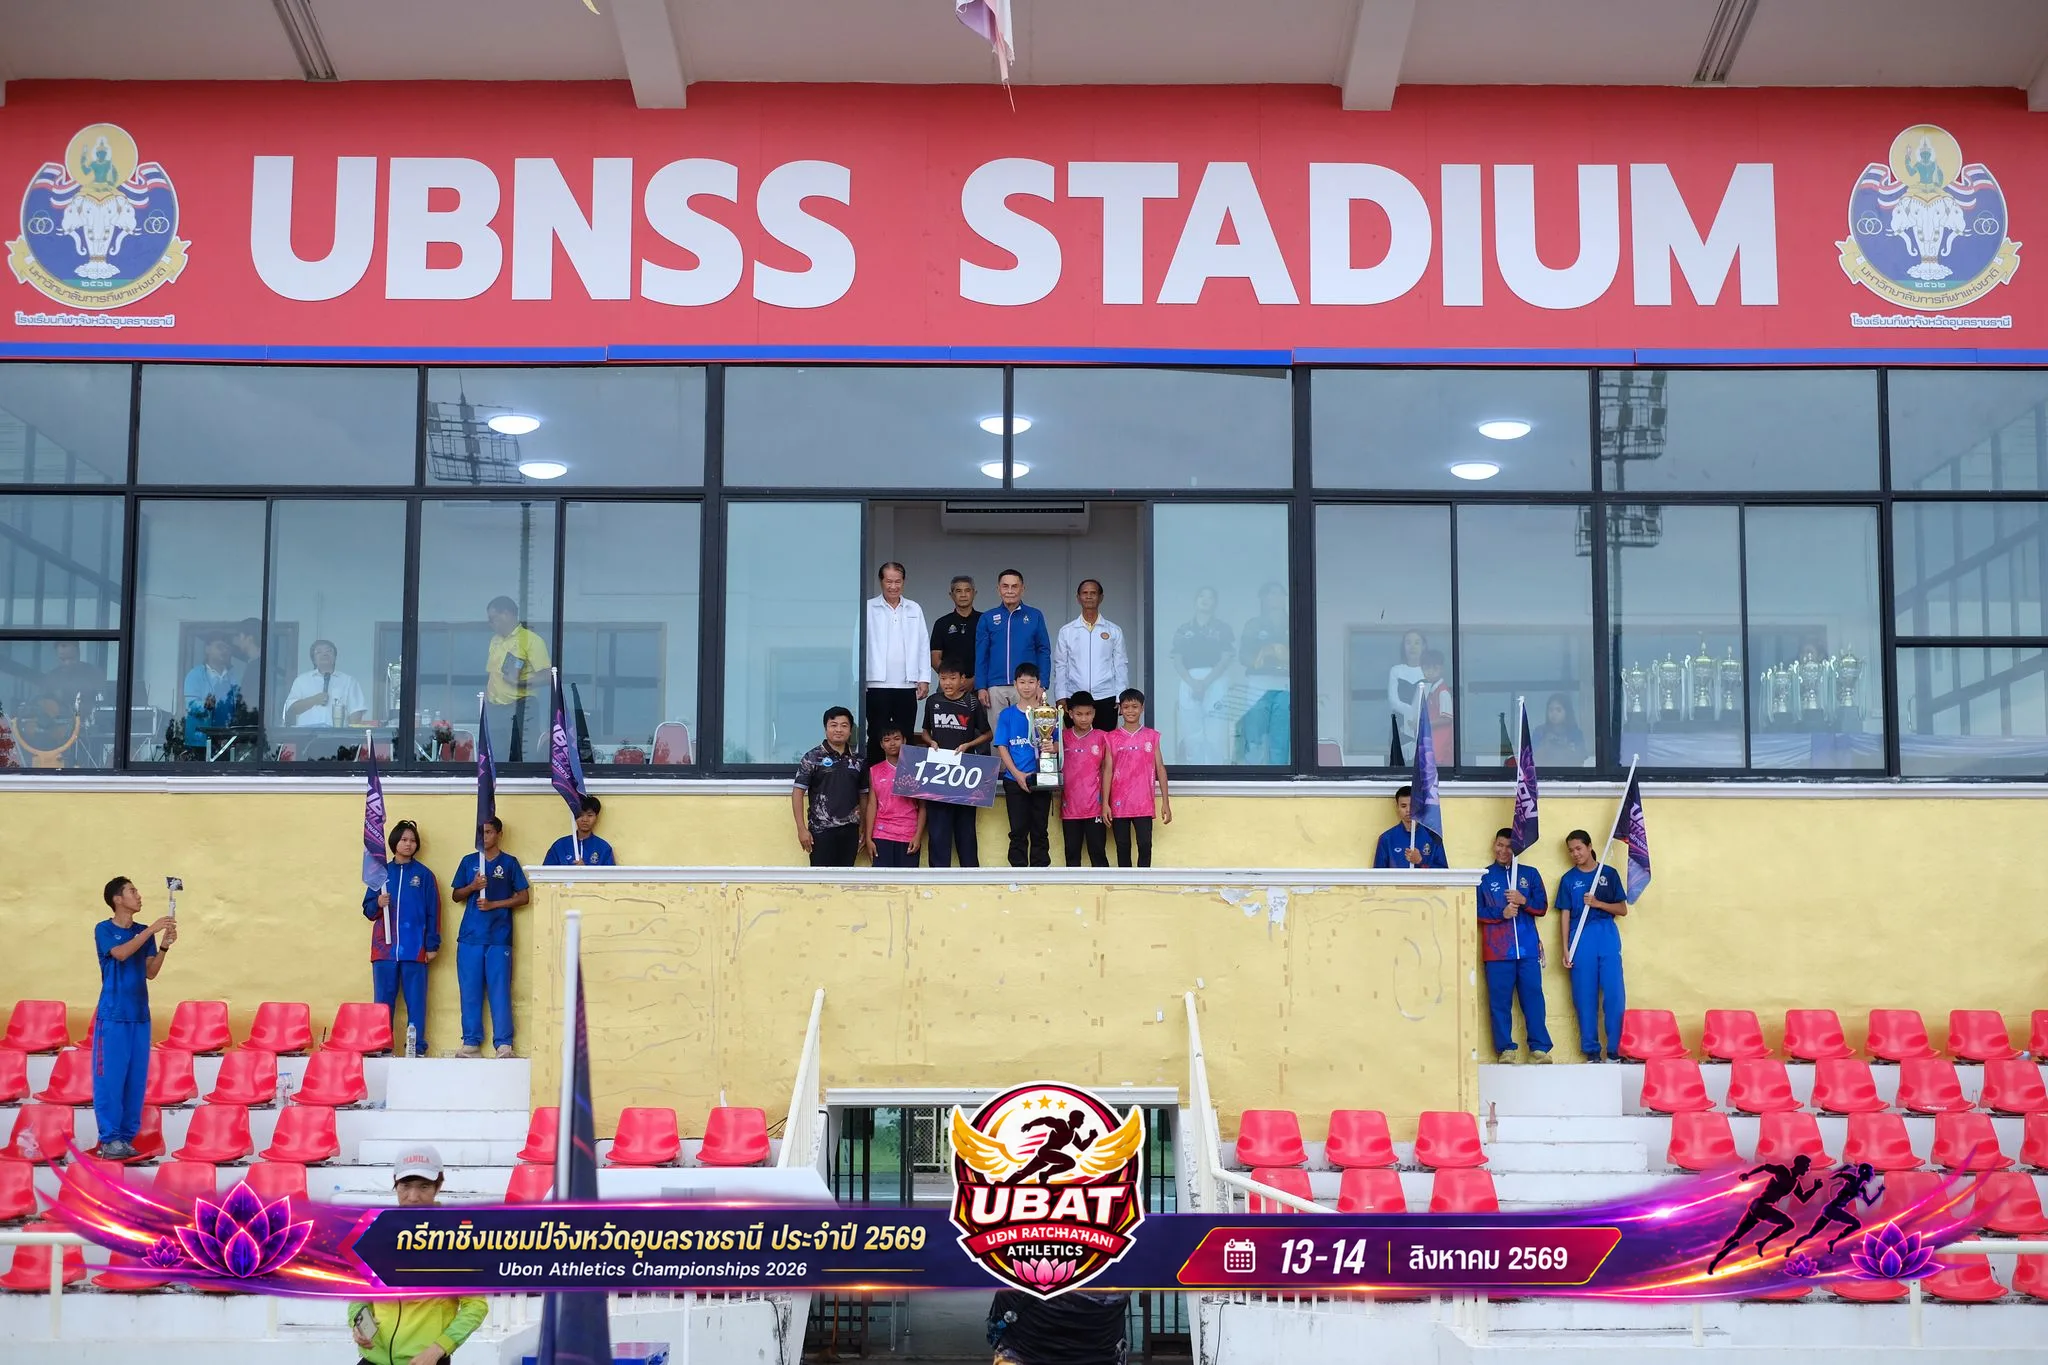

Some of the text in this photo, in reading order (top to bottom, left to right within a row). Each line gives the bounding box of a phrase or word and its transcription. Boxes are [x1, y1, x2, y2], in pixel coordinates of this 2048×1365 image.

[251, 156, 1778, 309] UBNSS STADIUM
[914, 760, 983, 789] 1,200
